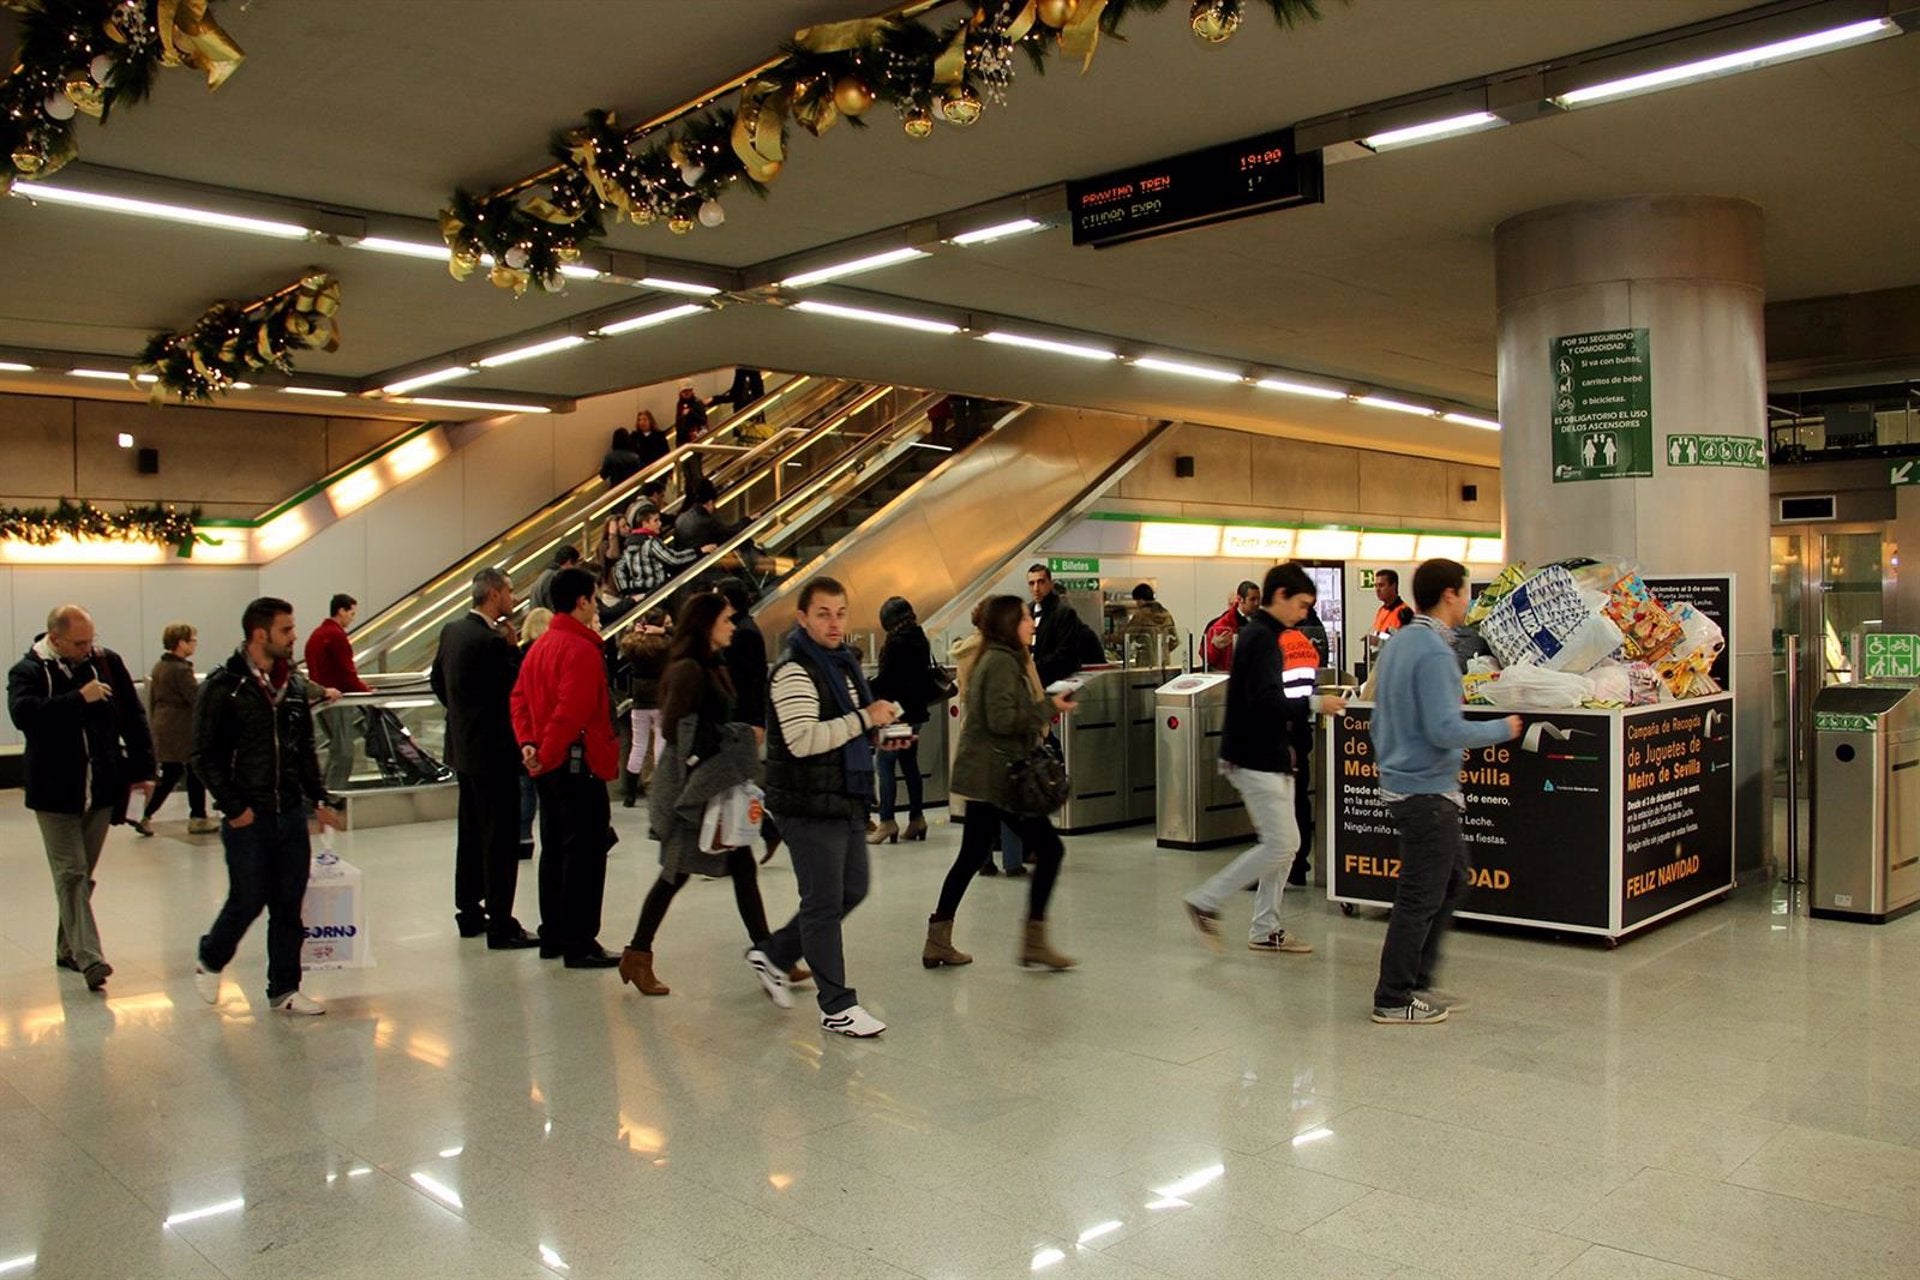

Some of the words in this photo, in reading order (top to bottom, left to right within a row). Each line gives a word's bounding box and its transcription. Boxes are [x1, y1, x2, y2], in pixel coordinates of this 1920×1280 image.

[1140, 175, 1171, 194] TREN
[1562, 337, 1577, 347] POR
[1578, 336, 1588, 345] SU
[1589, 332, 1634, 343] SEGURIDAD
[1600, 358, 1614, 366] con
[1581, 377, 1610, 387] carritos
[1611, 376, 1622, 384] de
[1623, 374, 1643, 383] bebé
[1554, 417, 1562, 425] ES
[1563, 411, 1618, 424] OBLIGATORIO
[1619, 411, 1629, 419] EL
[1630, 410, 1648, 418] USO
[1561, 425, 1572, 433] DE
[1572, 423, 1587, 432] LOS
[1588, 419, 1641, 431] ASCENSORES
[1627, 722, 1660, 740] Campaña
[1661, 719, 1670, 734] de
[1672, 714, 1701, 732] Recogida
[1344, 736, 1368, 755] de
[1483, 744, 1510, 764] de
[1627, 747, 1641, 768] de
[1645, 740, 1686, 767] Juguetes
[1689, 734, 1701, 753] de
[1344, 760, 1381, 778] Met
[1458, 768, 1511, 786] evilla
[1627, 770, 1656, 791] Metro
[1658, 765, 1670, 783] de
[1673, 758, 1701, 780] Sevilla
[1344, 784, 1371, 795] Desde
[1466, 793, 1479, 804] de
[1344, 797, 1354, 805] en
[1355, 796, 1363, 805] la
[1343, 805, 1351, 815] A
[1351, 806, 1371, 817] favor
[1372, 808, 1383, 818] de
[1465, 815, 1495, 827] Leche.
[1373, 824, 1392, 835] niño
[1476, 833, 1507, 845] fiestas.
[1345, 854, 1403, 878] FELIZ
[1626, 869, 1657, 899] FELIZ
[1658, 854, 1700, 888] NAVIDAD
